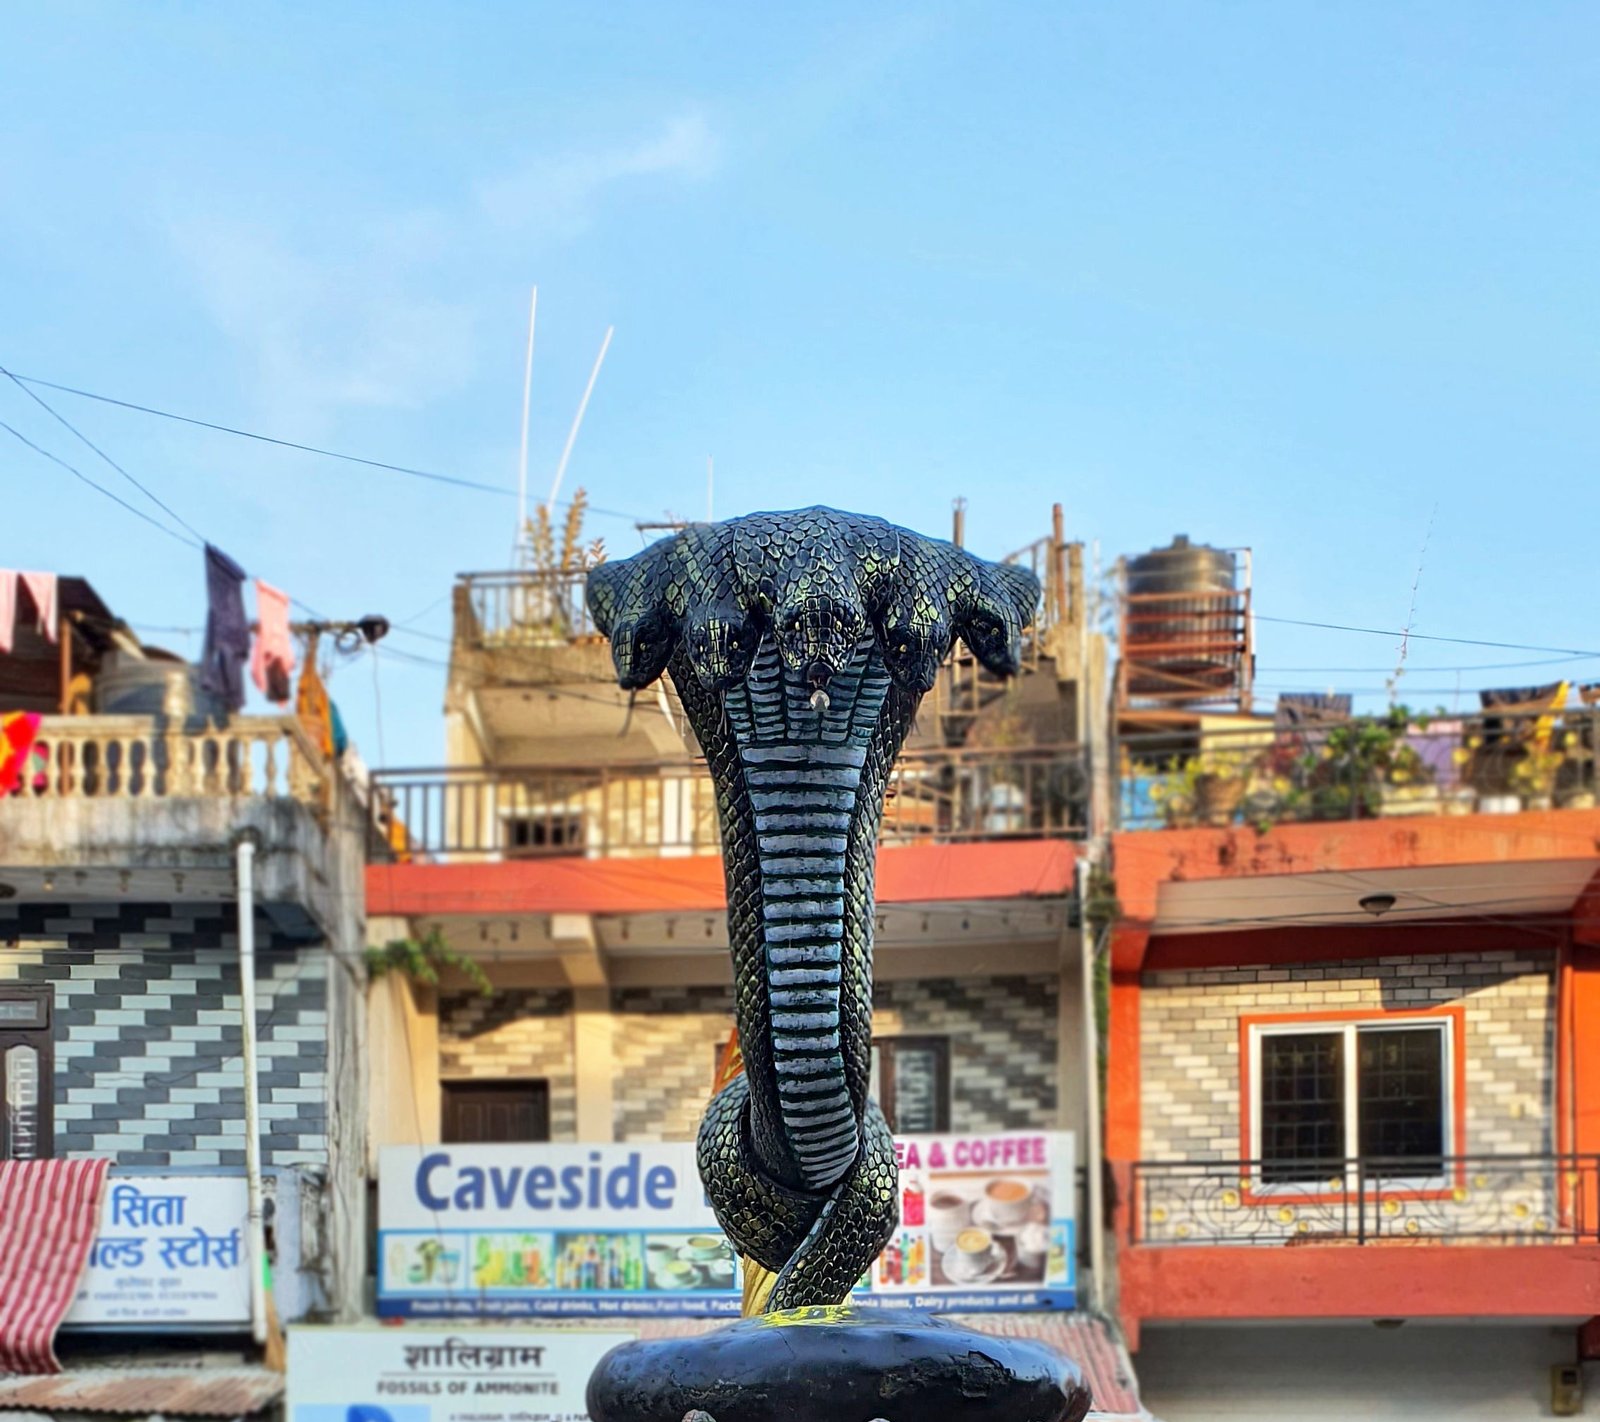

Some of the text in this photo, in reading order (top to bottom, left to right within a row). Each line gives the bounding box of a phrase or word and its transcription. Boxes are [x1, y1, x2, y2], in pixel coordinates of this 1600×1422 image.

[894, 1137, 1046, 1169] EA & COFFEE
[415, 1151, 677, 1211] Caveside
[112, 1184, 187, 1228] सिता
[160, 1227, 242, 1269] स्टोर्स
[915, 1296, 944, 1309] Dairy
[998, 1294, 1019, 1304] and
[402, 1336, 546, 1371] शालिग्राम
[377, 1380, 559, 1395] FOSSILS OF AMMONITE
